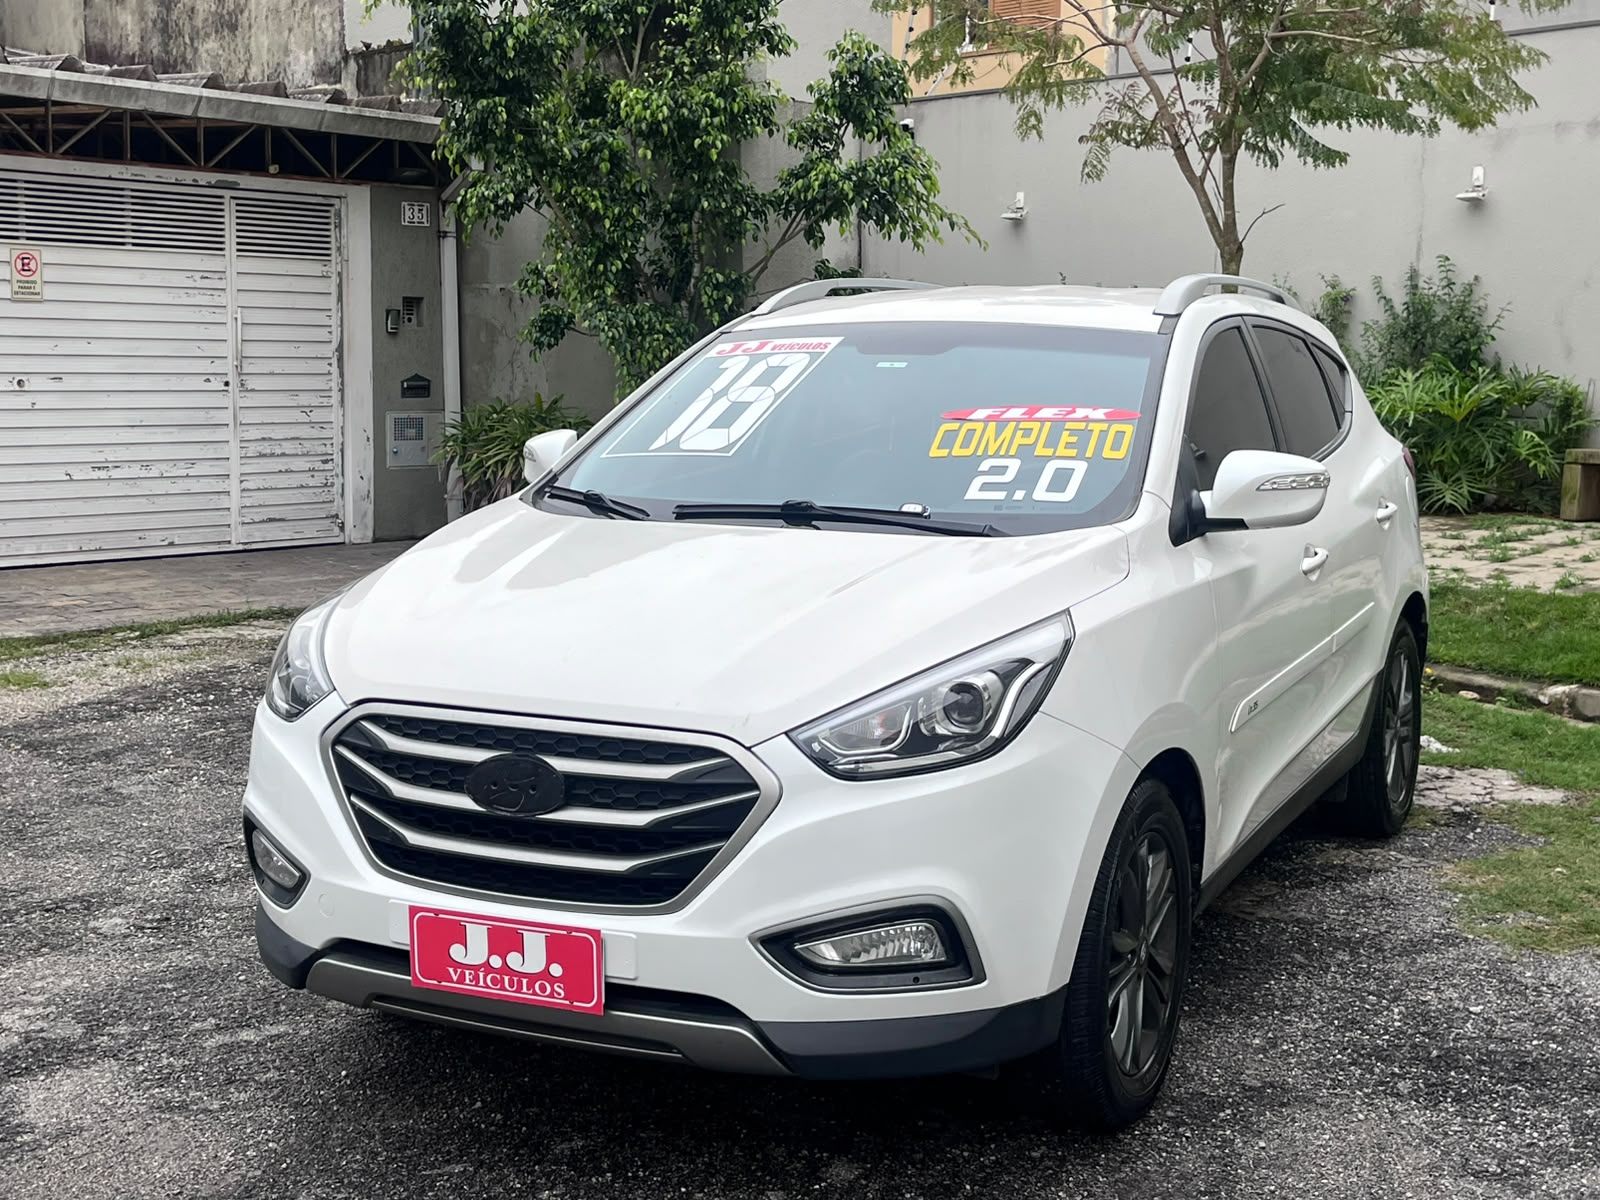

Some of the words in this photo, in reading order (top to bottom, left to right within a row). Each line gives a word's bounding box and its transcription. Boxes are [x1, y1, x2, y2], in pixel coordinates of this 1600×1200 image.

[408, 207, 424, 220] 35
[21, 257, 31, 271] E
[648, 353, 810, 451] 18
[967, 407, 1114, 419] FLEX
[929, 421, 1135, 459] COMPLETO
[963, 458, 1089, 502] 2.0
[449, 922, 563, 977] J.J.
[446, 967, 565, 999] VEÍCULOS
